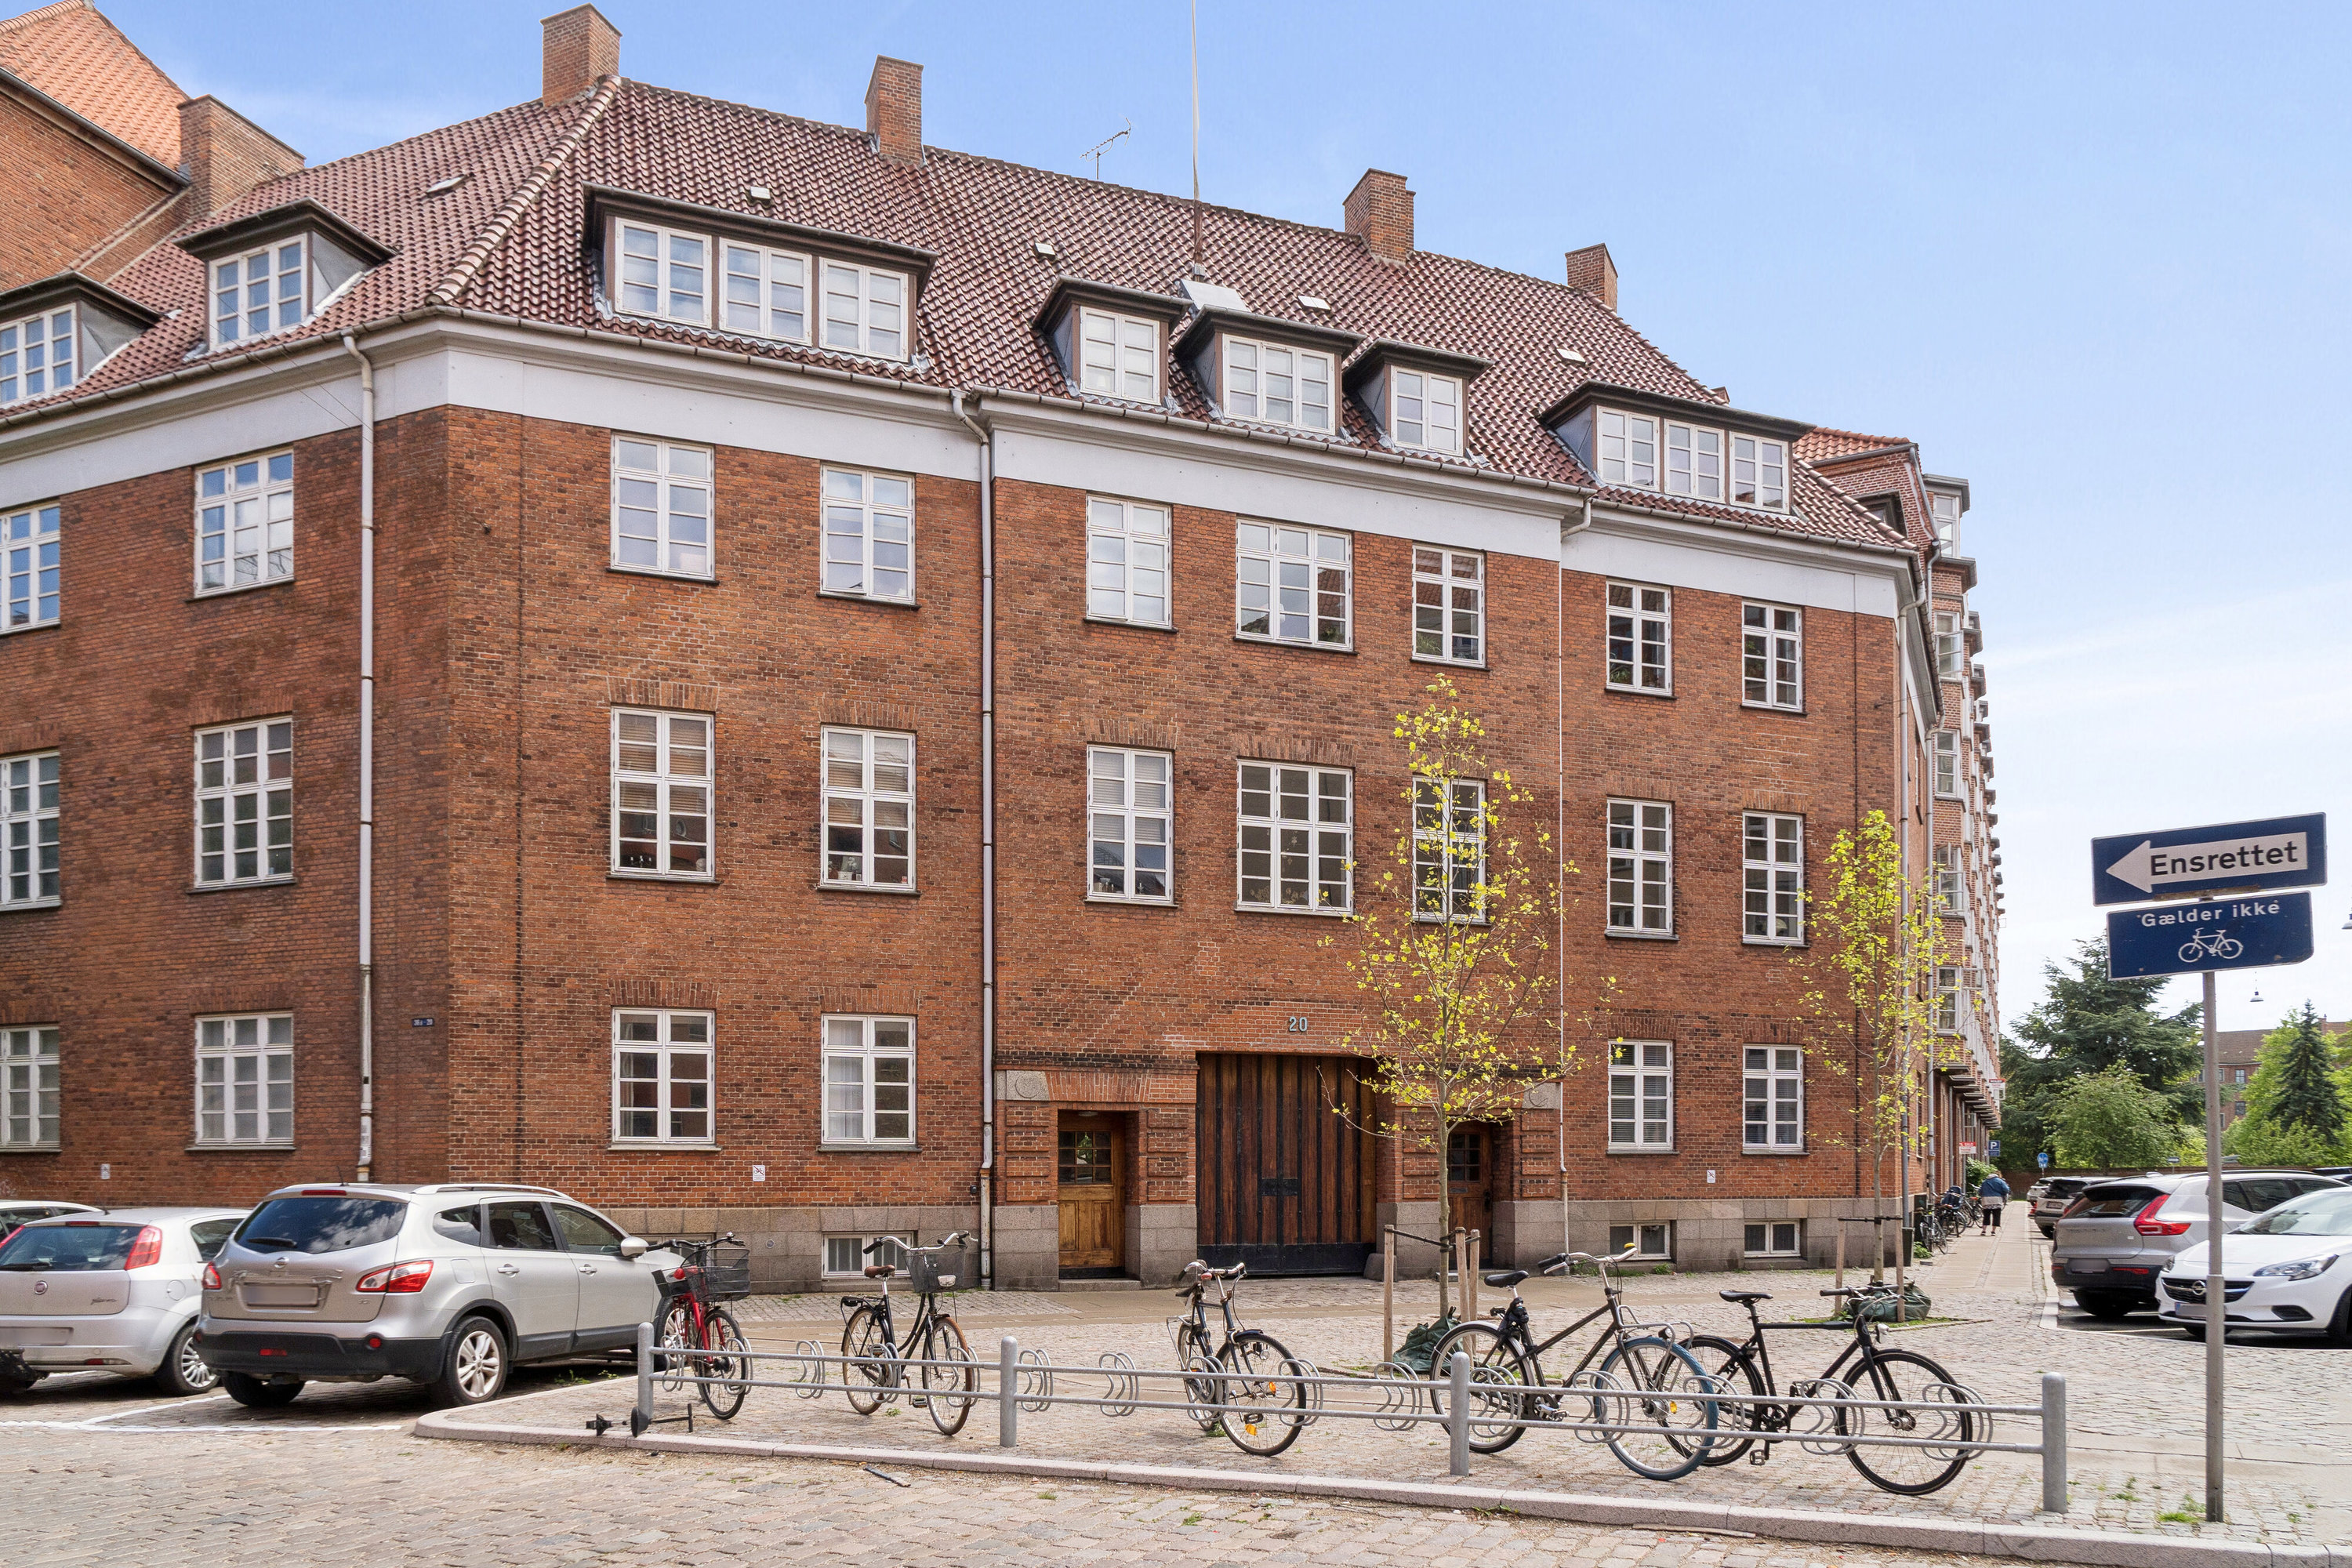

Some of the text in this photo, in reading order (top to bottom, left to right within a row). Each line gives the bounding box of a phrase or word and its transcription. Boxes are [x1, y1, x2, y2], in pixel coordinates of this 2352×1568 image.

[2151, 841, 2298, 876] Ensrettet
[2141, 902, 2280, 927] Gælder ikke
[1289, 1016, 1308, 1032] 20
